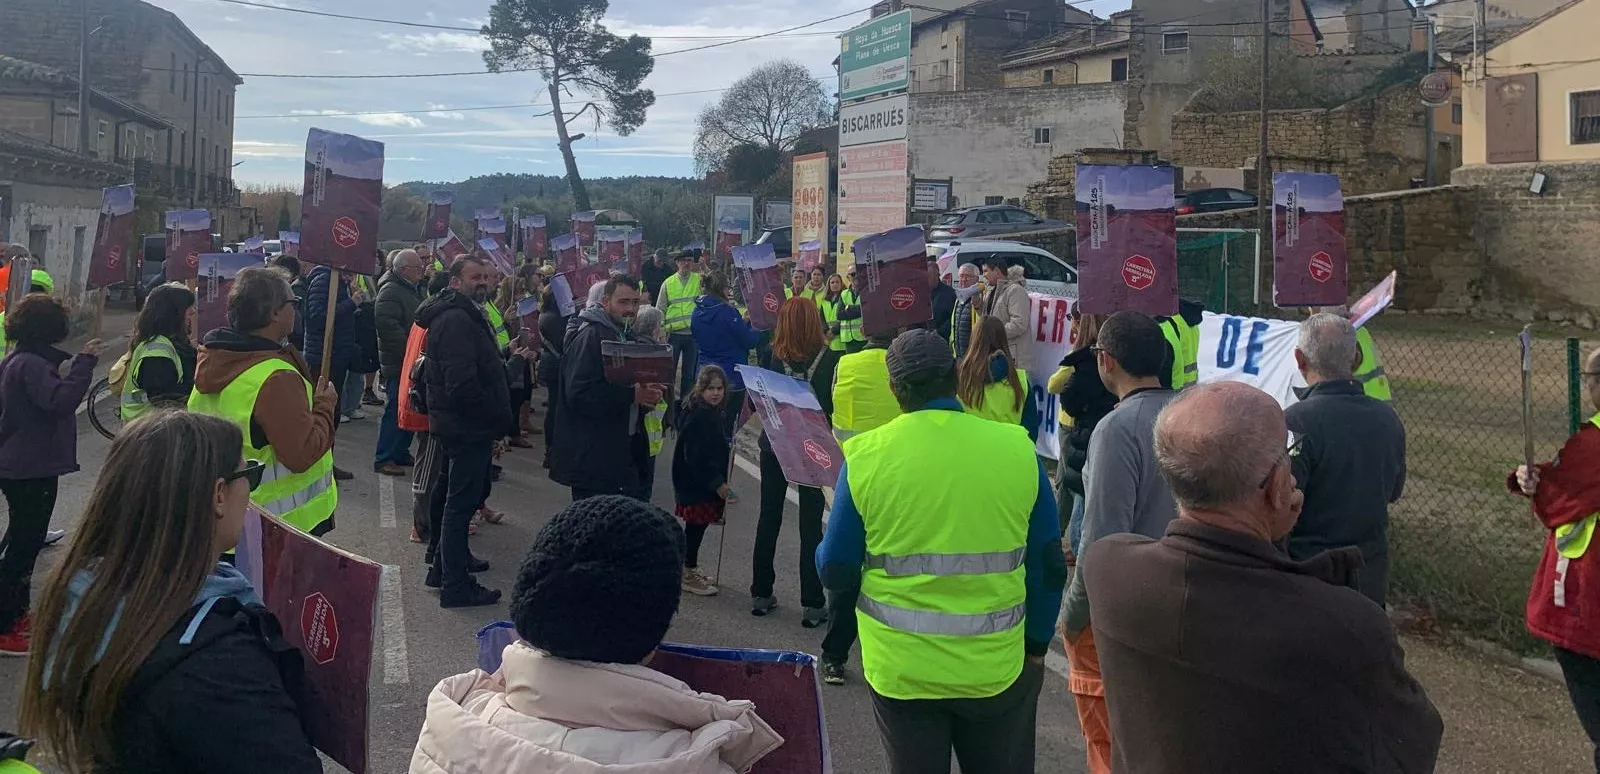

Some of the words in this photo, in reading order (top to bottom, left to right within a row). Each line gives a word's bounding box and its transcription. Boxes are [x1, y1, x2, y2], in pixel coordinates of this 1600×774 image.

[842, 105, 904, 134] BISCARRUÉS
[1216, 317, 1269, 376] DE
[308, 597, 323, 648] CARRETERA
[313, 604, 328, 654] ARREGLADA
